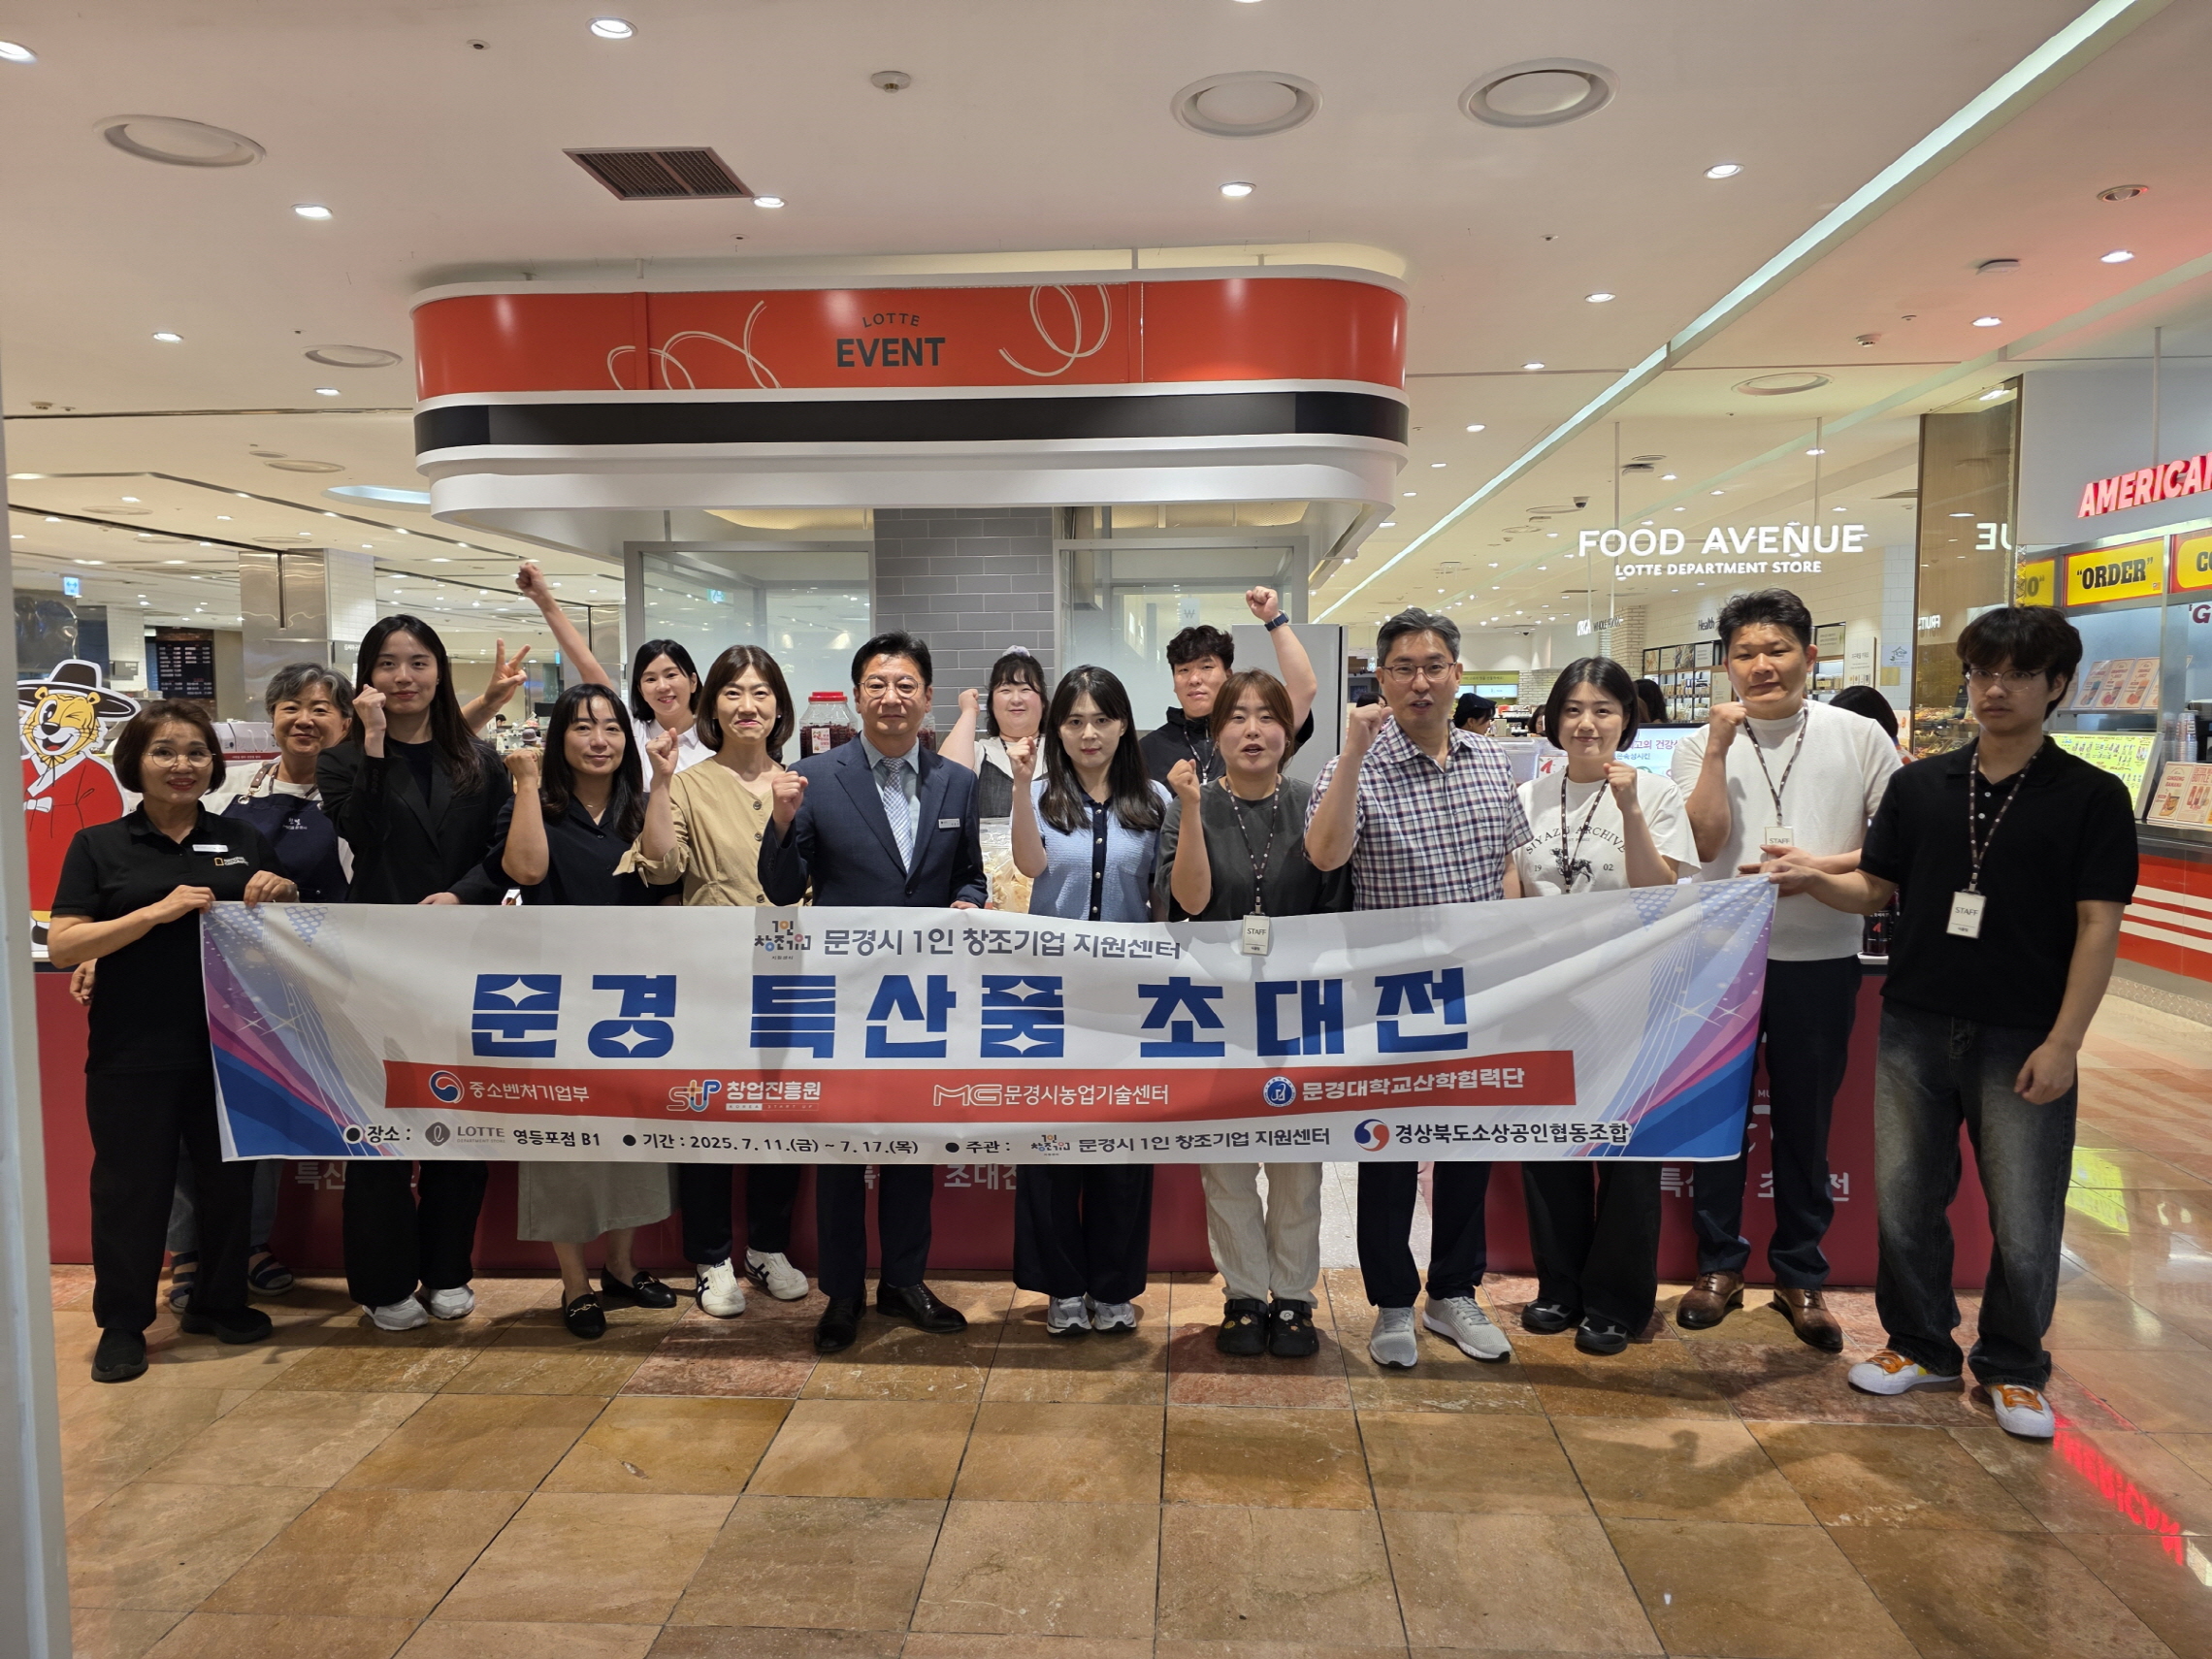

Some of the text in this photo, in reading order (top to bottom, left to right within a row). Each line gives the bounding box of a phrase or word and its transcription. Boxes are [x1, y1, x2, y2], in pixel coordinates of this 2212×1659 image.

[862, 312, 921, 328] LOTTE
[836, 337, 946, 368] EVENT
[1578, 524, 1865, 557] FOOD AVENUE
[1614, 561, 1822, 577] LOTTE DEPARTMENT STORE
[1698, 616, 1715, 631] Health
[1576, 826, 1626, 854] ARCHIVE
[1955, 906, 1979, 916] STAFF
[824, 927, 1181, 960] 문경시 1인 창조기업 지원센터
[472, 966, 1468, 1059] 문경 특산품 초대전
[469, 1081, 590, 1102] 중소벤처기업부
[726, 1081, 822, 1101] 창업진흥원
[1302, 1067, 1525, 1101] 문경대학교산학협력단
[1003, 1084, 1169, 1105] 문경시농업기술센터
[367, 1125, 400, 1144] 장소
[457, 1125, 505, 1138] LOTTE
[513, 1129, 600, 1147] 영등포점 B1
[643, 1133, 675, 1149] 기간
[1078, 1127, 1330, 1153] 문경시 1인 창조기업 지원센터
[1395, 1122, 1630, 1144] 경상북도소상공인협동조합
[965, 1140, 1000, 1154] 주관
